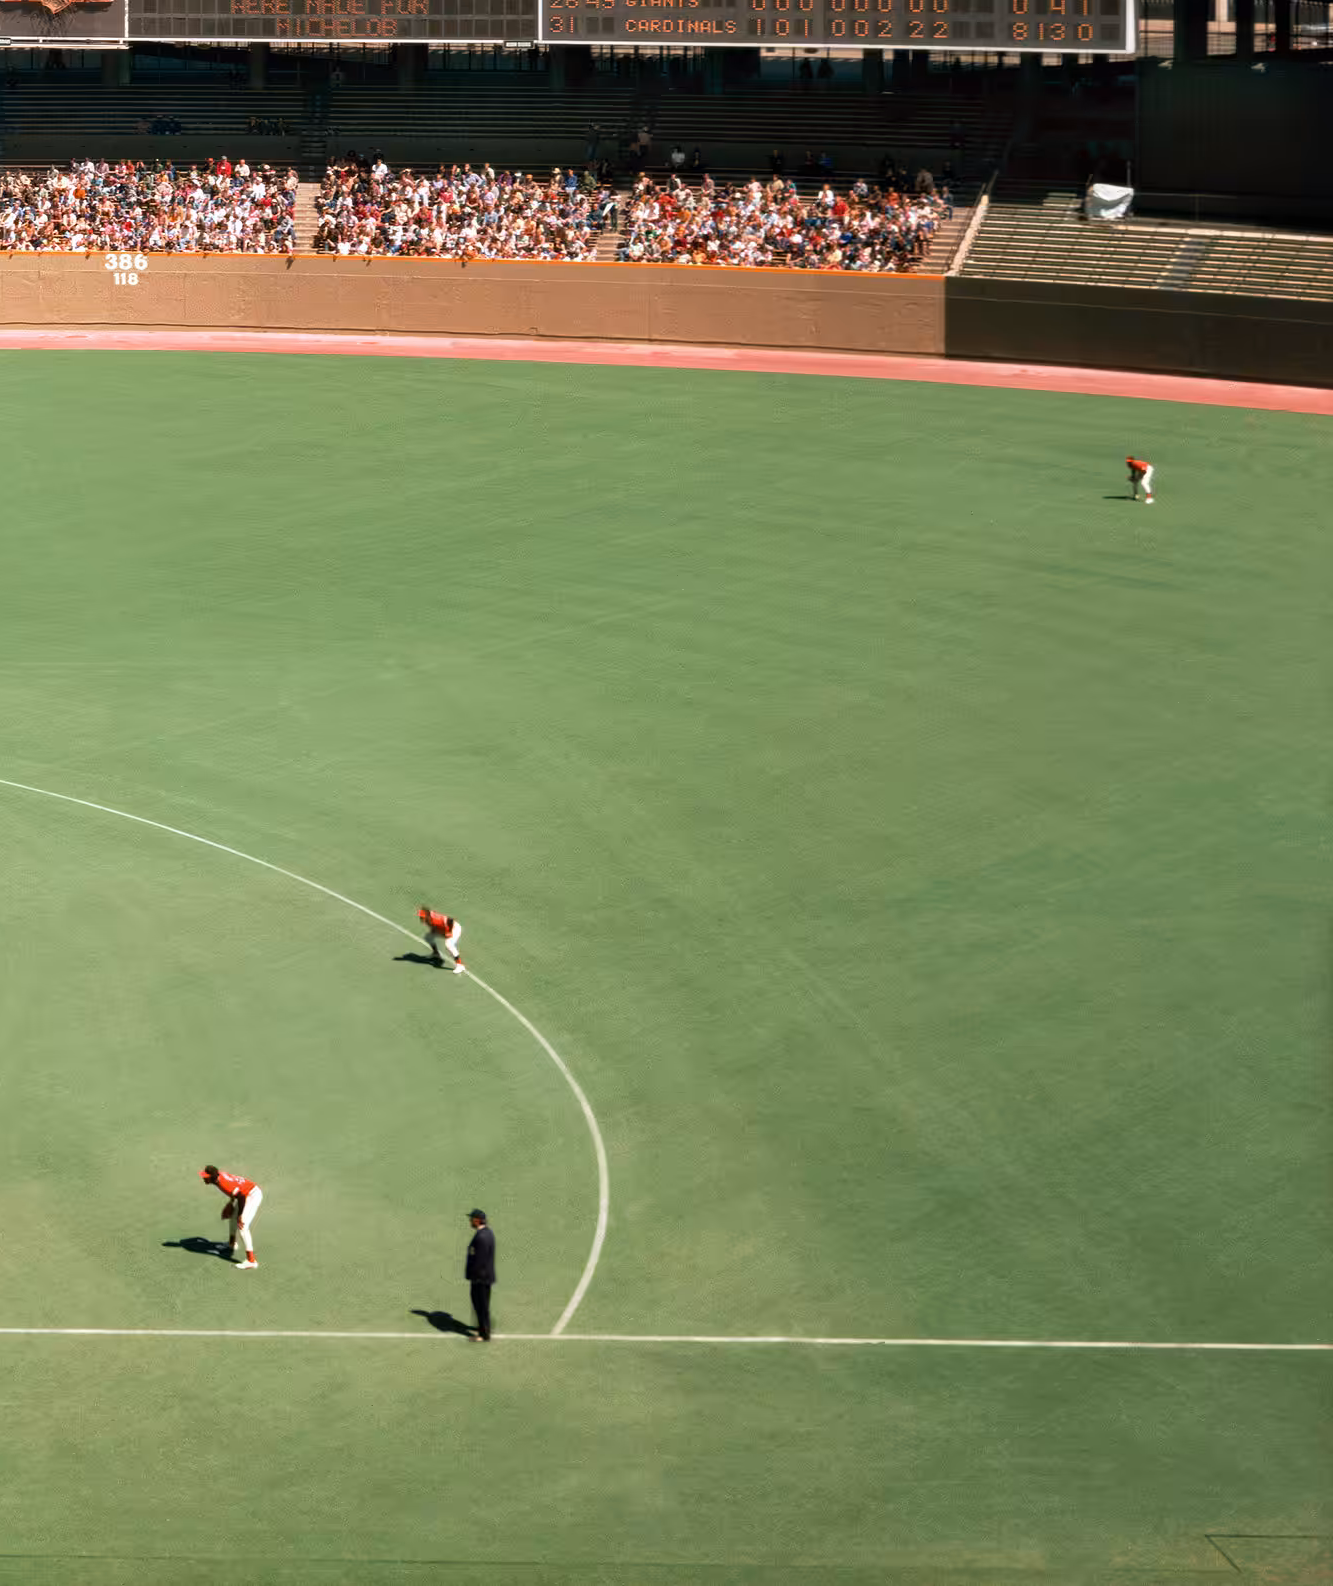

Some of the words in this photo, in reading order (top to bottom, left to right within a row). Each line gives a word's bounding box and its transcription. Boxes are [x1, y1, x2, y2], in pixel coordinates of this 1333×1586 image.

[276, 17, 397, 37] MICHELOB
[549, 16, 574, 33] 31
[625, 19, 737, 34] CARDINALS
[104, 253, 148, 271] 386
[113, 272, 139, 285] 118
